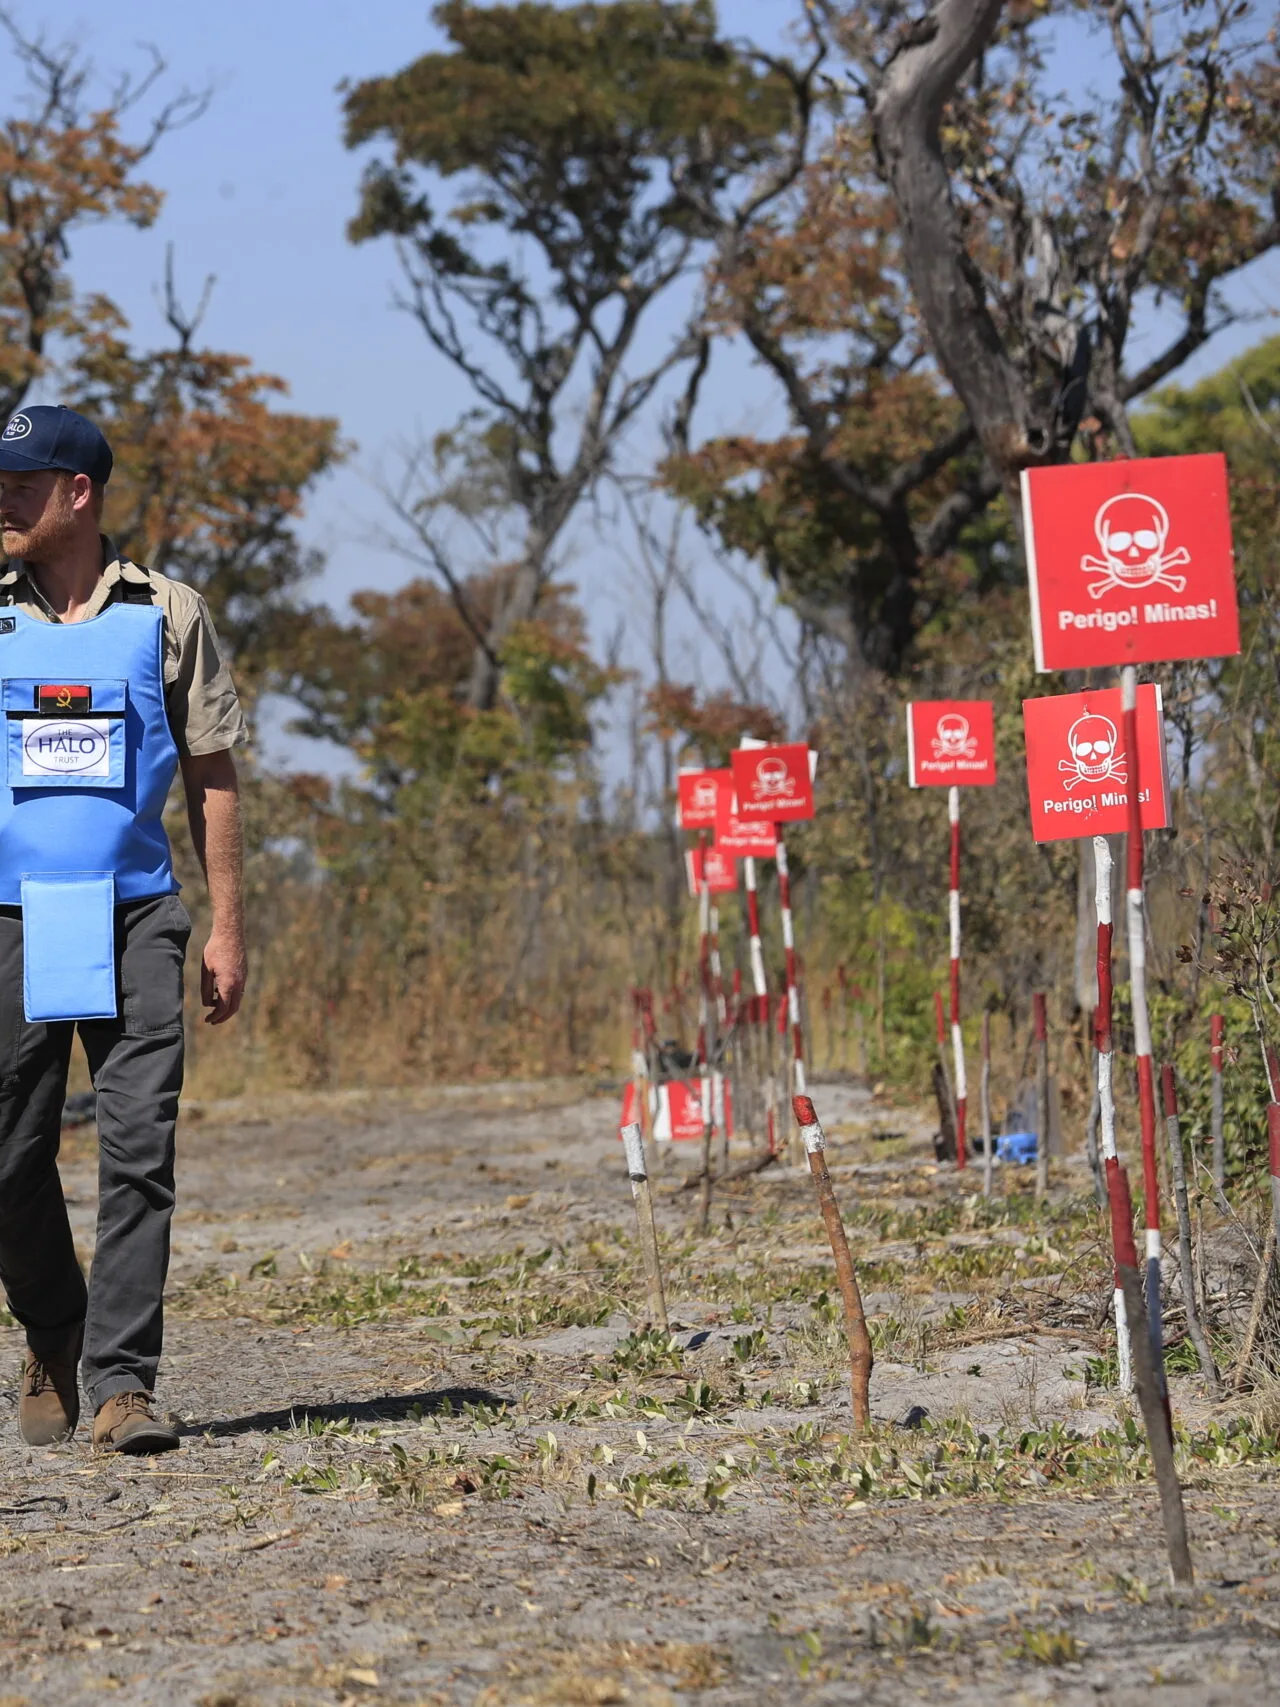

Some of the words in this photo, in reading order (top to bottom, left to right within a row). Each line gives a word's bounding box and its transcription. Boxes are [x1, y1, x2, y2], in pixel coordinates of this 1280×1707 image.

[1058, 605, 1138, 632] Perigo!
[1144, 598, 1217, 624] Minas!
[39, 736, 96, 754] HALO
[54, 756, 80, 764] TRUST
[920, 759, 955, 773] Perigo!
[955, 759, 988, 771] Minas!
[1043, 795, 1097, 813] Perigo!
[1101, 788, 1151, 807] Mins!
